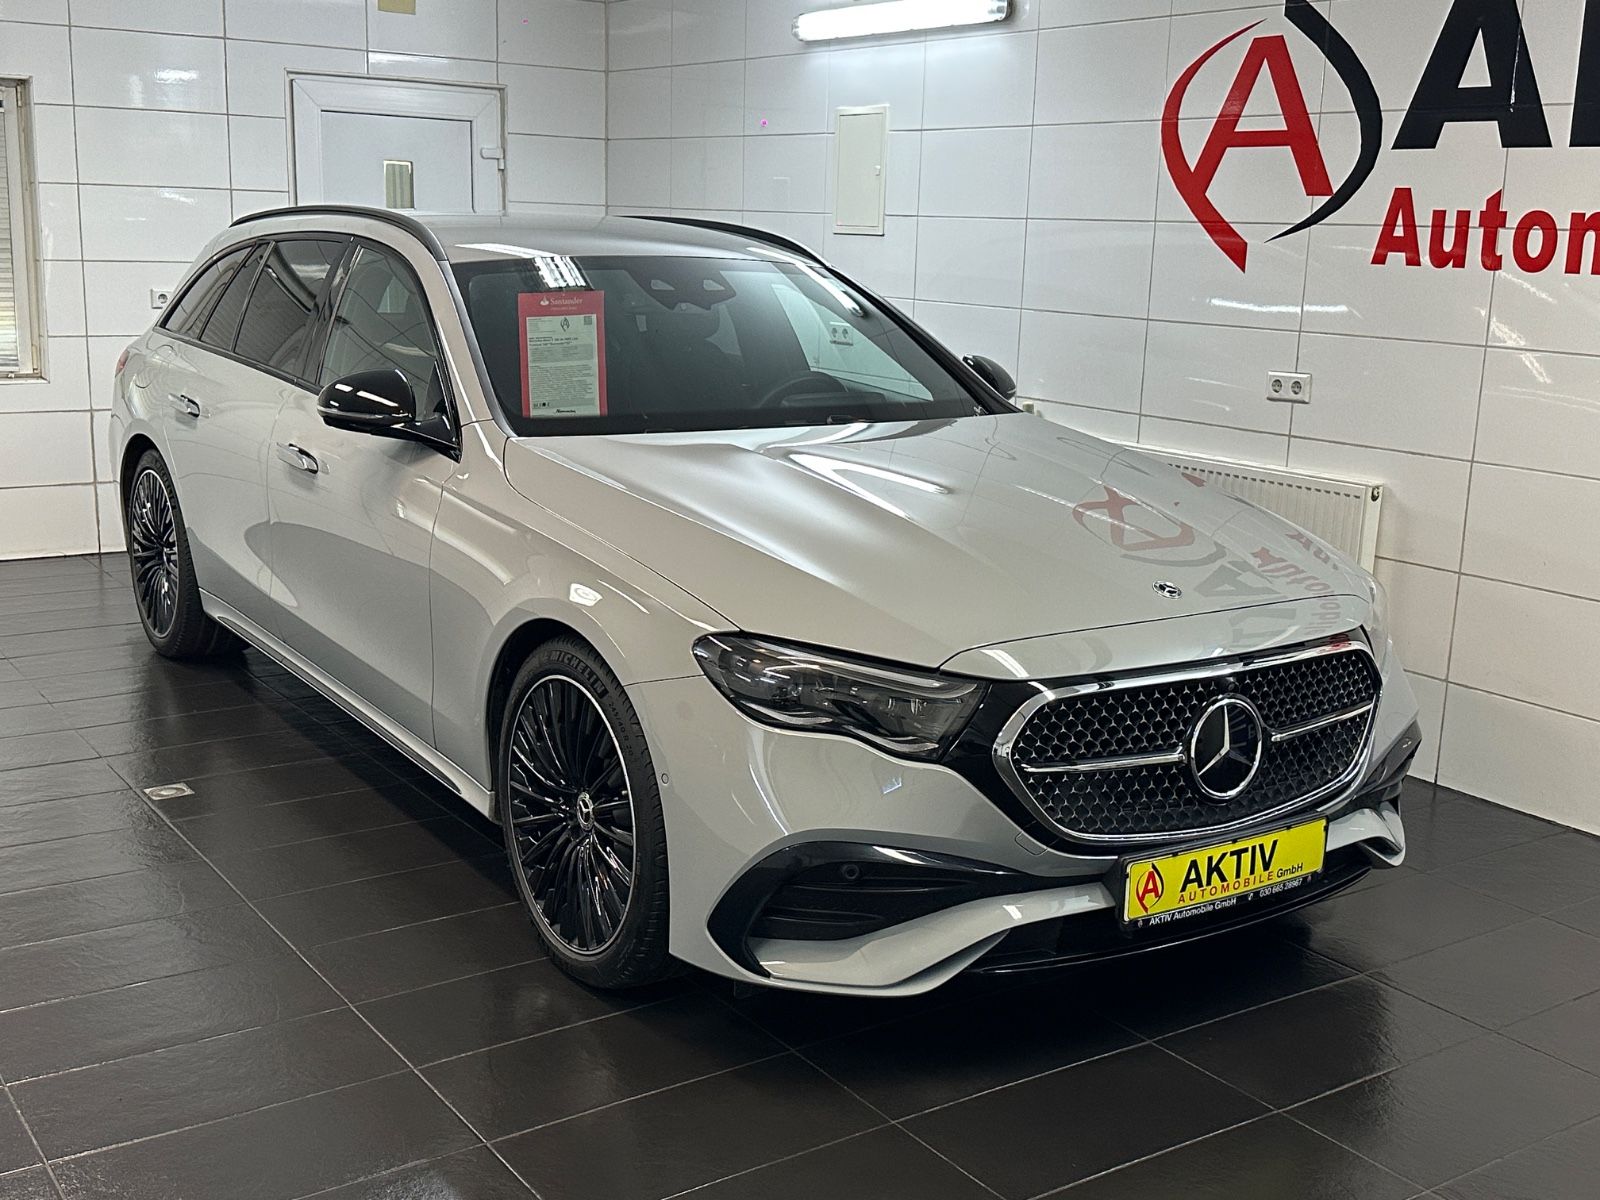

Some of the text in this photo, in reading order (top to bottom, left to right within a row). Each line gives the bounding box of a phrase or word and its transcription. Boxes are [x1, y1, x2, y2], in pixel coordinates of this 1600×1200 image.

[550, 650, 605, 695] MICHELIN
[1178, 862, 1304, 904] AUTOMOBILE GmbH
[1180, 839, 1279, 893] AKTIV
[1149, 913, 1173, 926] AKTIV
[1173, 903, 1214, 920] Automobile
[1214, 897, 1237, 910] GmbH
[1259, 887, 1272, 898] 030
[1272, 884, 1284, 894] 665
